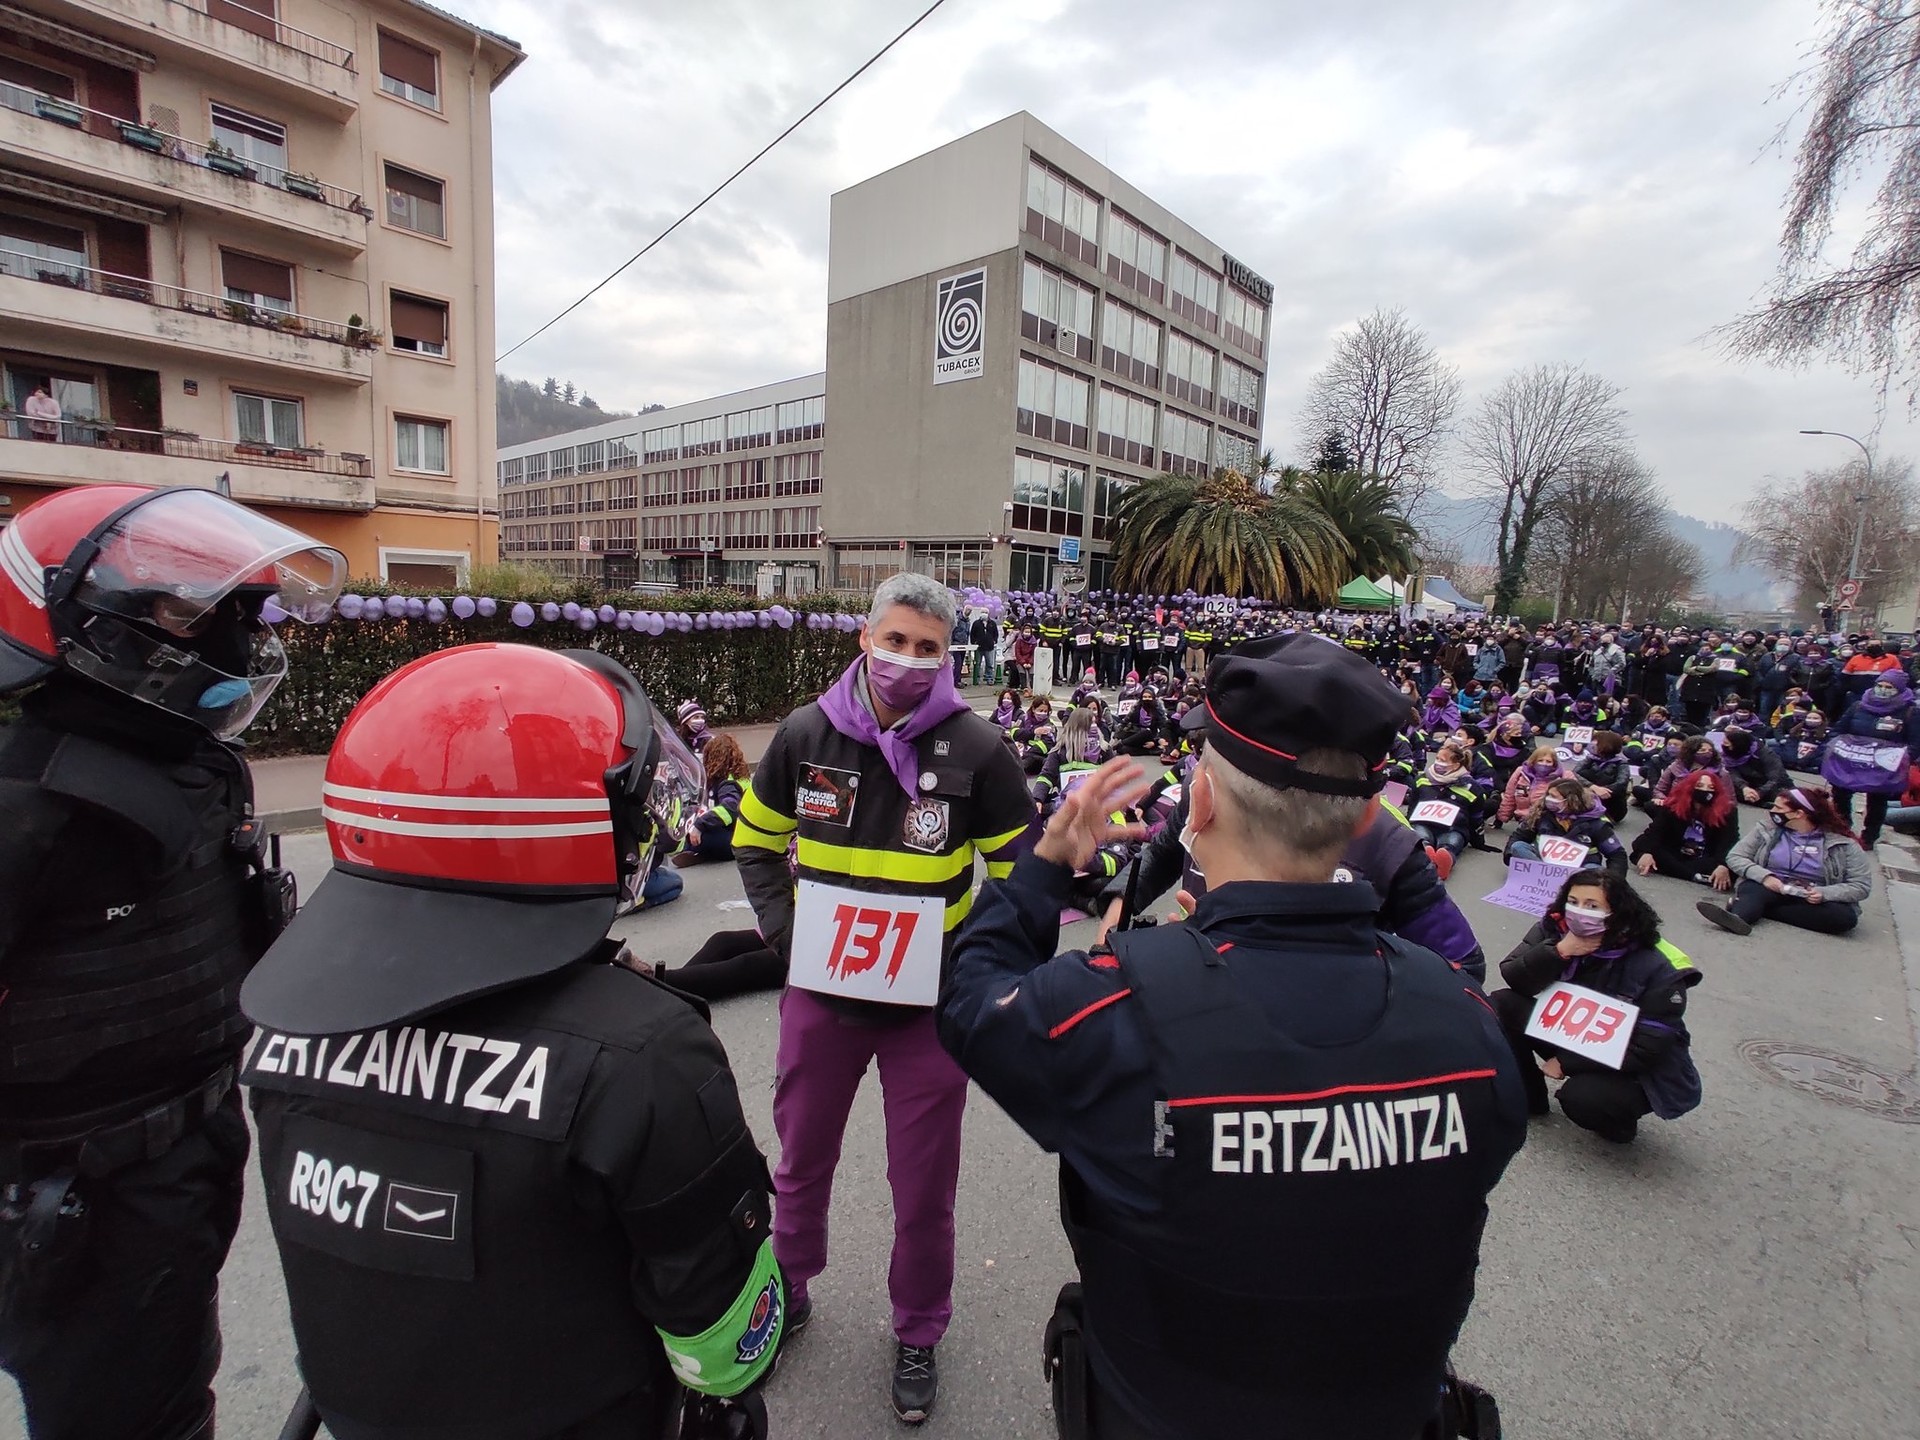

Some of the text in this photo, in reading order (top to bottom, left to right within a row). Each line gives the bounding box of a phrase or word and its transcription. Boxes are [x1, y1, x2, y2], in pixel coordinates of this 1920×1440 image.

[937, 357, 981, 373] TUBACEX
[1206, 601, 1235, 613] 026
[1568, 729, 1590, 740] 072
[804, 796, 837, 808] CASTIGA
[809, 790, 837, 801] MUJER
[1419, 804, 1453, 819] 010
[1542, 839, 1581, 862] 008
[1514, 861, 1531, 873] EN
[1537, 878, 1549, 887] NI
[1520, 885, 1558, 899] FORMAD
[107, 903, 136, 920] PO
[826, 904, 919, 989] 131
[1537, 990, 1627, 1044] 003
[1212, 1092, 1468, 1174] ERTZAINTZA
[290, 1150, 380, 1229] R9C7
